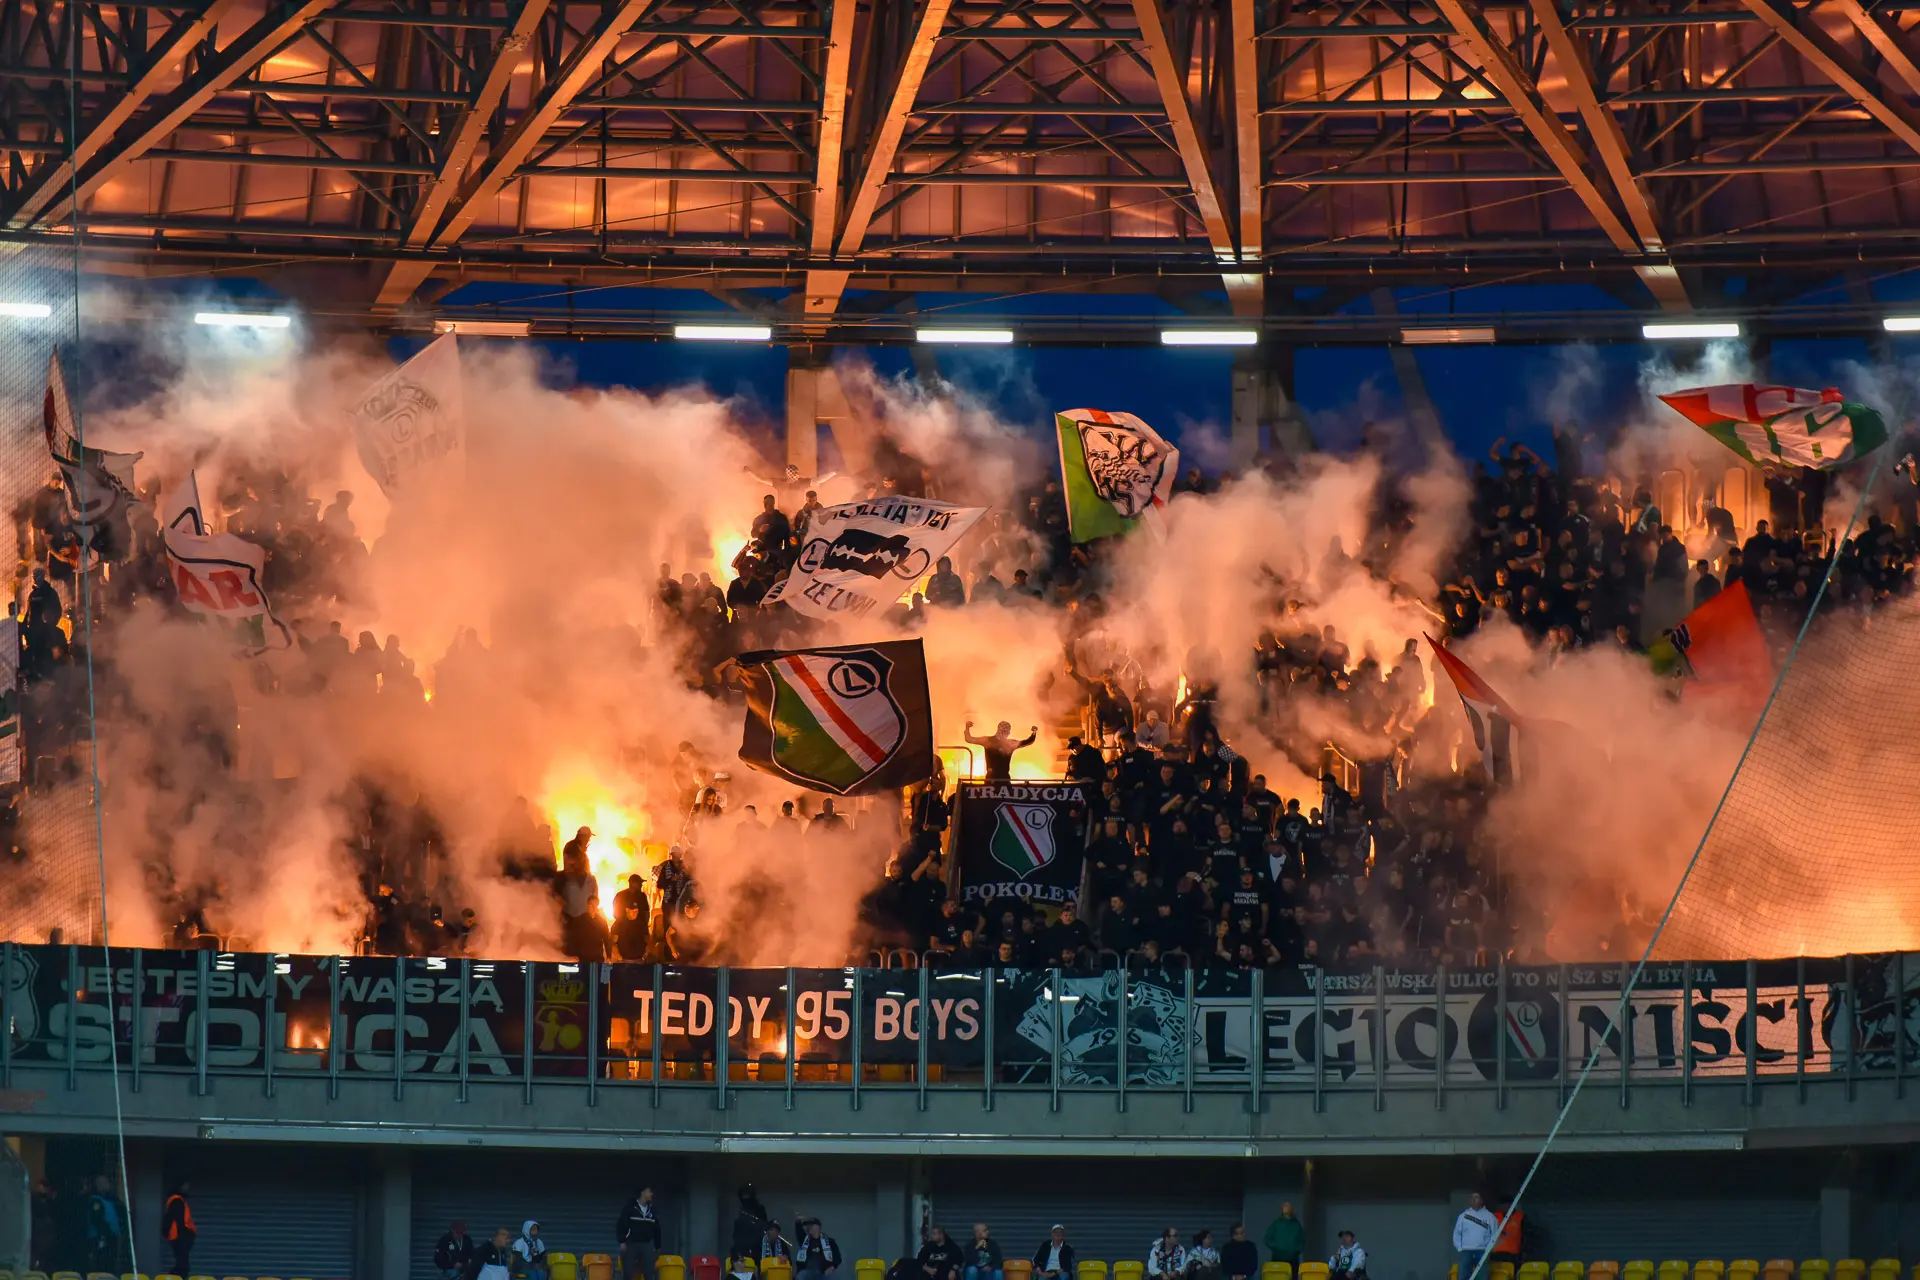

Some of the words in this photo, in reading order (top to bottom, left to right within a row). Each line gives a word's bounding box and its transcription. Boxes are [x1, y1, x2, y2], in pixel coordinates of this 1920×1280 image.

[169, 563, 260, 611] AR
[965, 785, 1087, 804] TRADYCJA
[1449, 972, 1503, 988] ULIC
[1512, 970, 1540, 987] TO
[47, 1002, 512, 1076] STOLICA
[633, 989, 771, 1039] TEDDY
[794, 990, 852, 1040] 95
[875, 997, 980, 1041] BOYS
